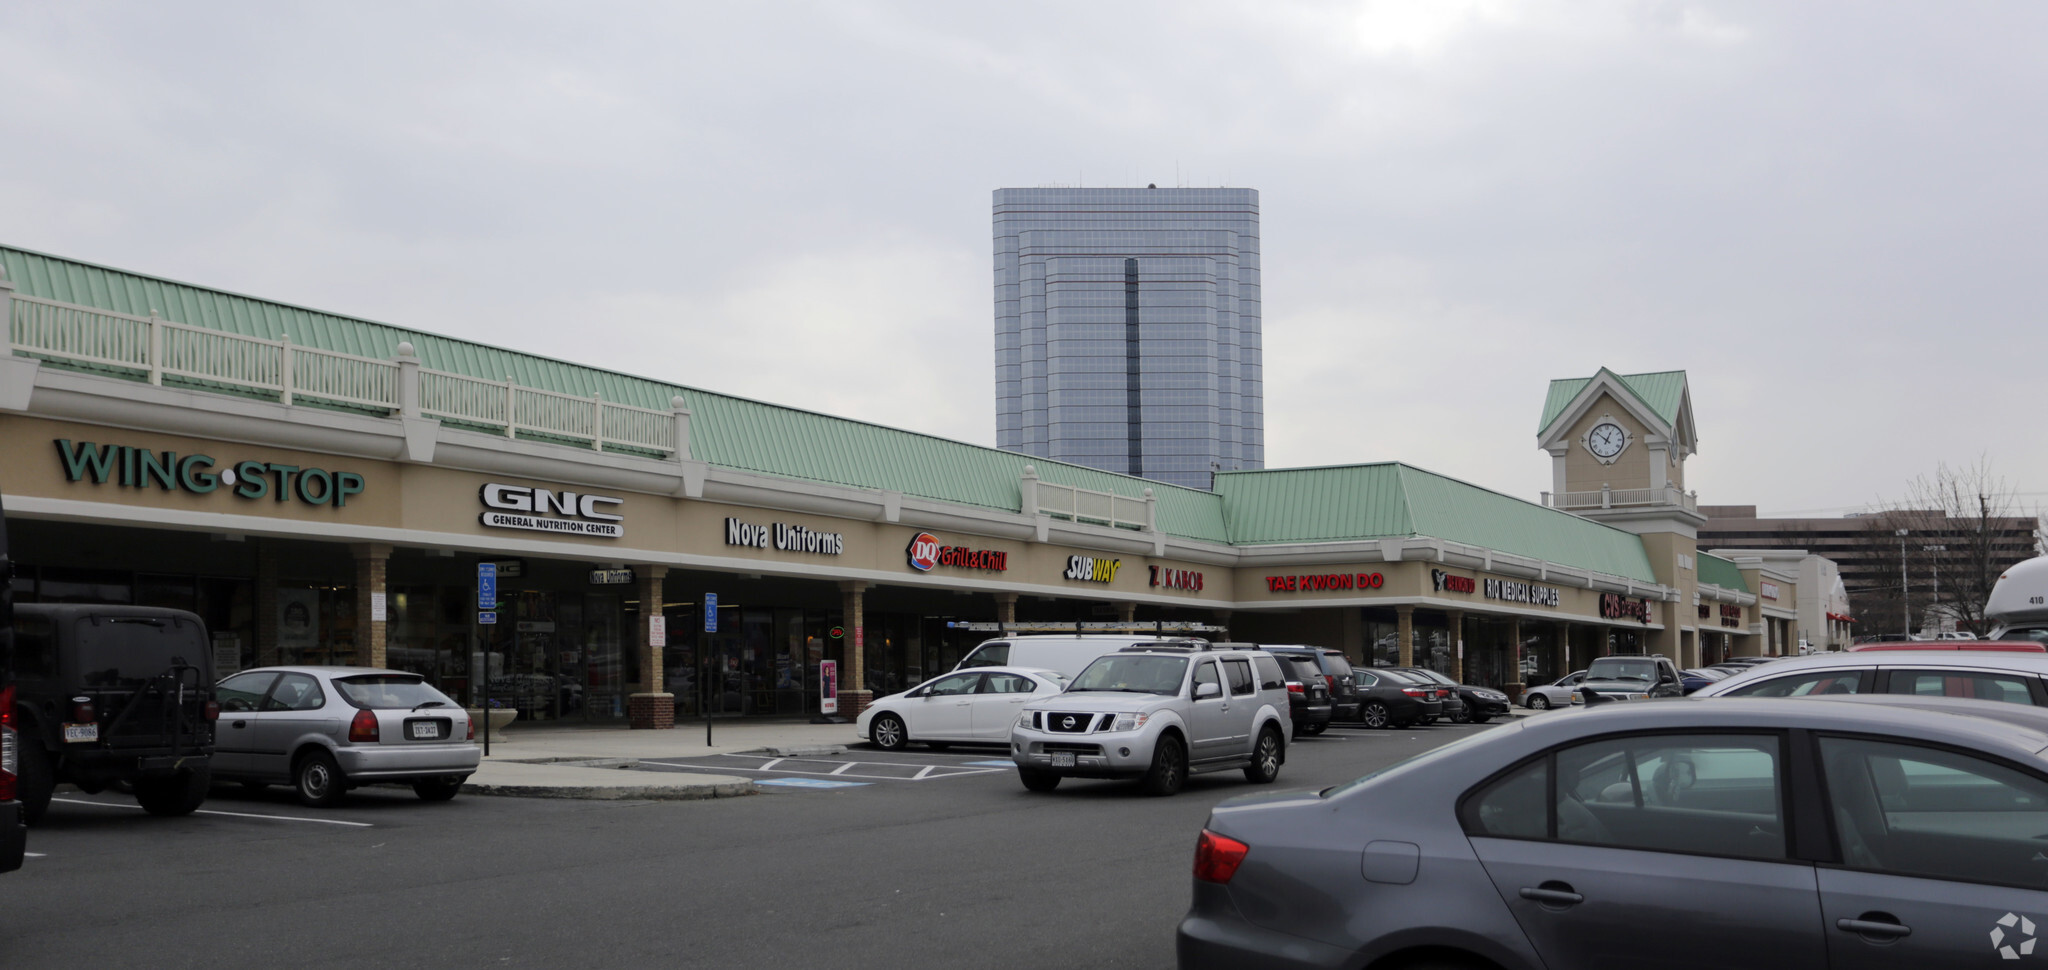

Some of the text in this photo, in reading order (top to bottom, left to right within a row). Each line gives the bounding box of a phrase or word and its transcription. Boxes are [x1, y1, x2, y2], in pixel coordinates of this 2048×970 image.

[54, 438, 365, 507] WING STOP
[481, 483, 624, 521] GNC
[493, 514, 616, 535] GENERAL NUTRITION CENTER
[727, 517, 843, 555] Nova Uniforms
[915, 541, 936, 563] DQ
[1066, 555, 1122, 583] SUBWAY
[1164, 567, 1204, 591] KABOB
[1265, 572, 1384, 592] TAE KWON DO
[1486, 578, 1559, 606] RIO MEDICAL SUPPLIES
[1604, 593, 1620, 618] CVS
[2029, 596, 2044, 605] 410
